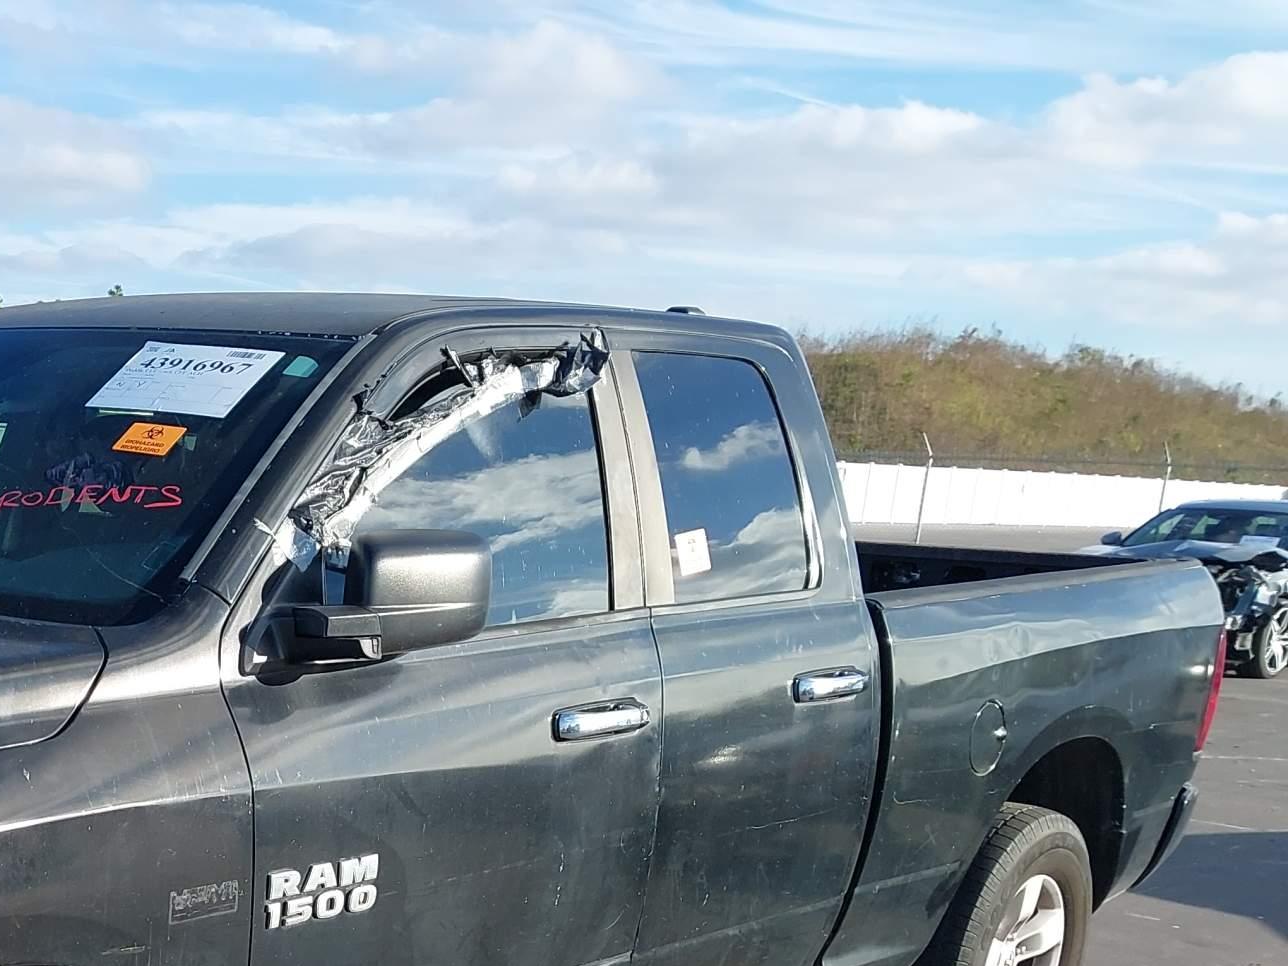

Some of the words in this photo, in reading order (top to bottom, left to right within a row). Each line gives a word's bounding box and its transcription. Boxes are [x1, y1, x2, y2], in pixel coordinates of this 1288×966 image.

[140, 357, 254, 375] 43916967
[125, 439, 165, 448] BIOHAZARD
[267, 853, 379, 900] RAM
[264, 884, 378, 930] 1500
